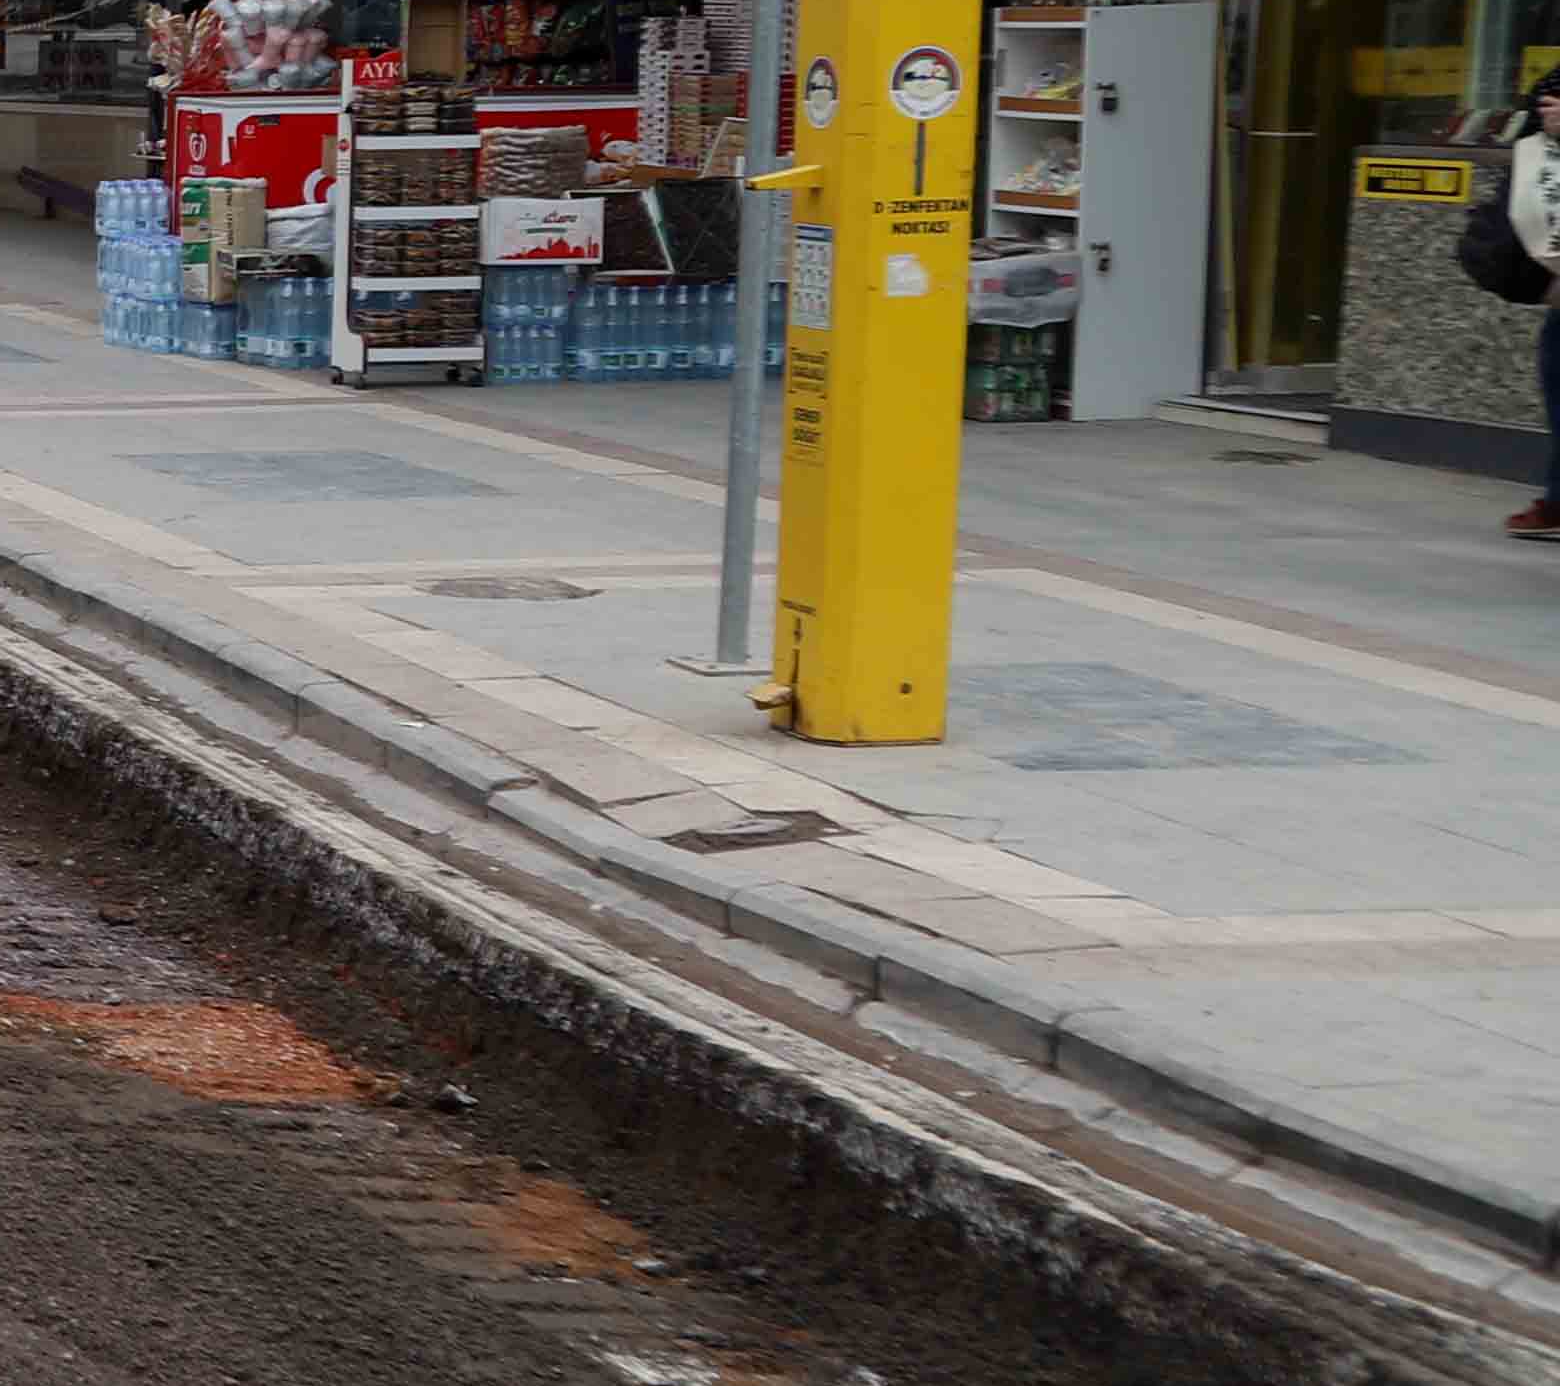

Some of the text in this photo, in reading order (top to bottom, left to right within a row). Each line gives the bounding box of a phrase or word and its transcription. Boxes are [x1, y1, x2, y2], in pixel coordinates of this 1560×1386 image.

[361, 61, 403, 81] AYK
[874, 199, 969, 215] DZENFEKTAN
[892, 221, 950, 235] NOKTASI
